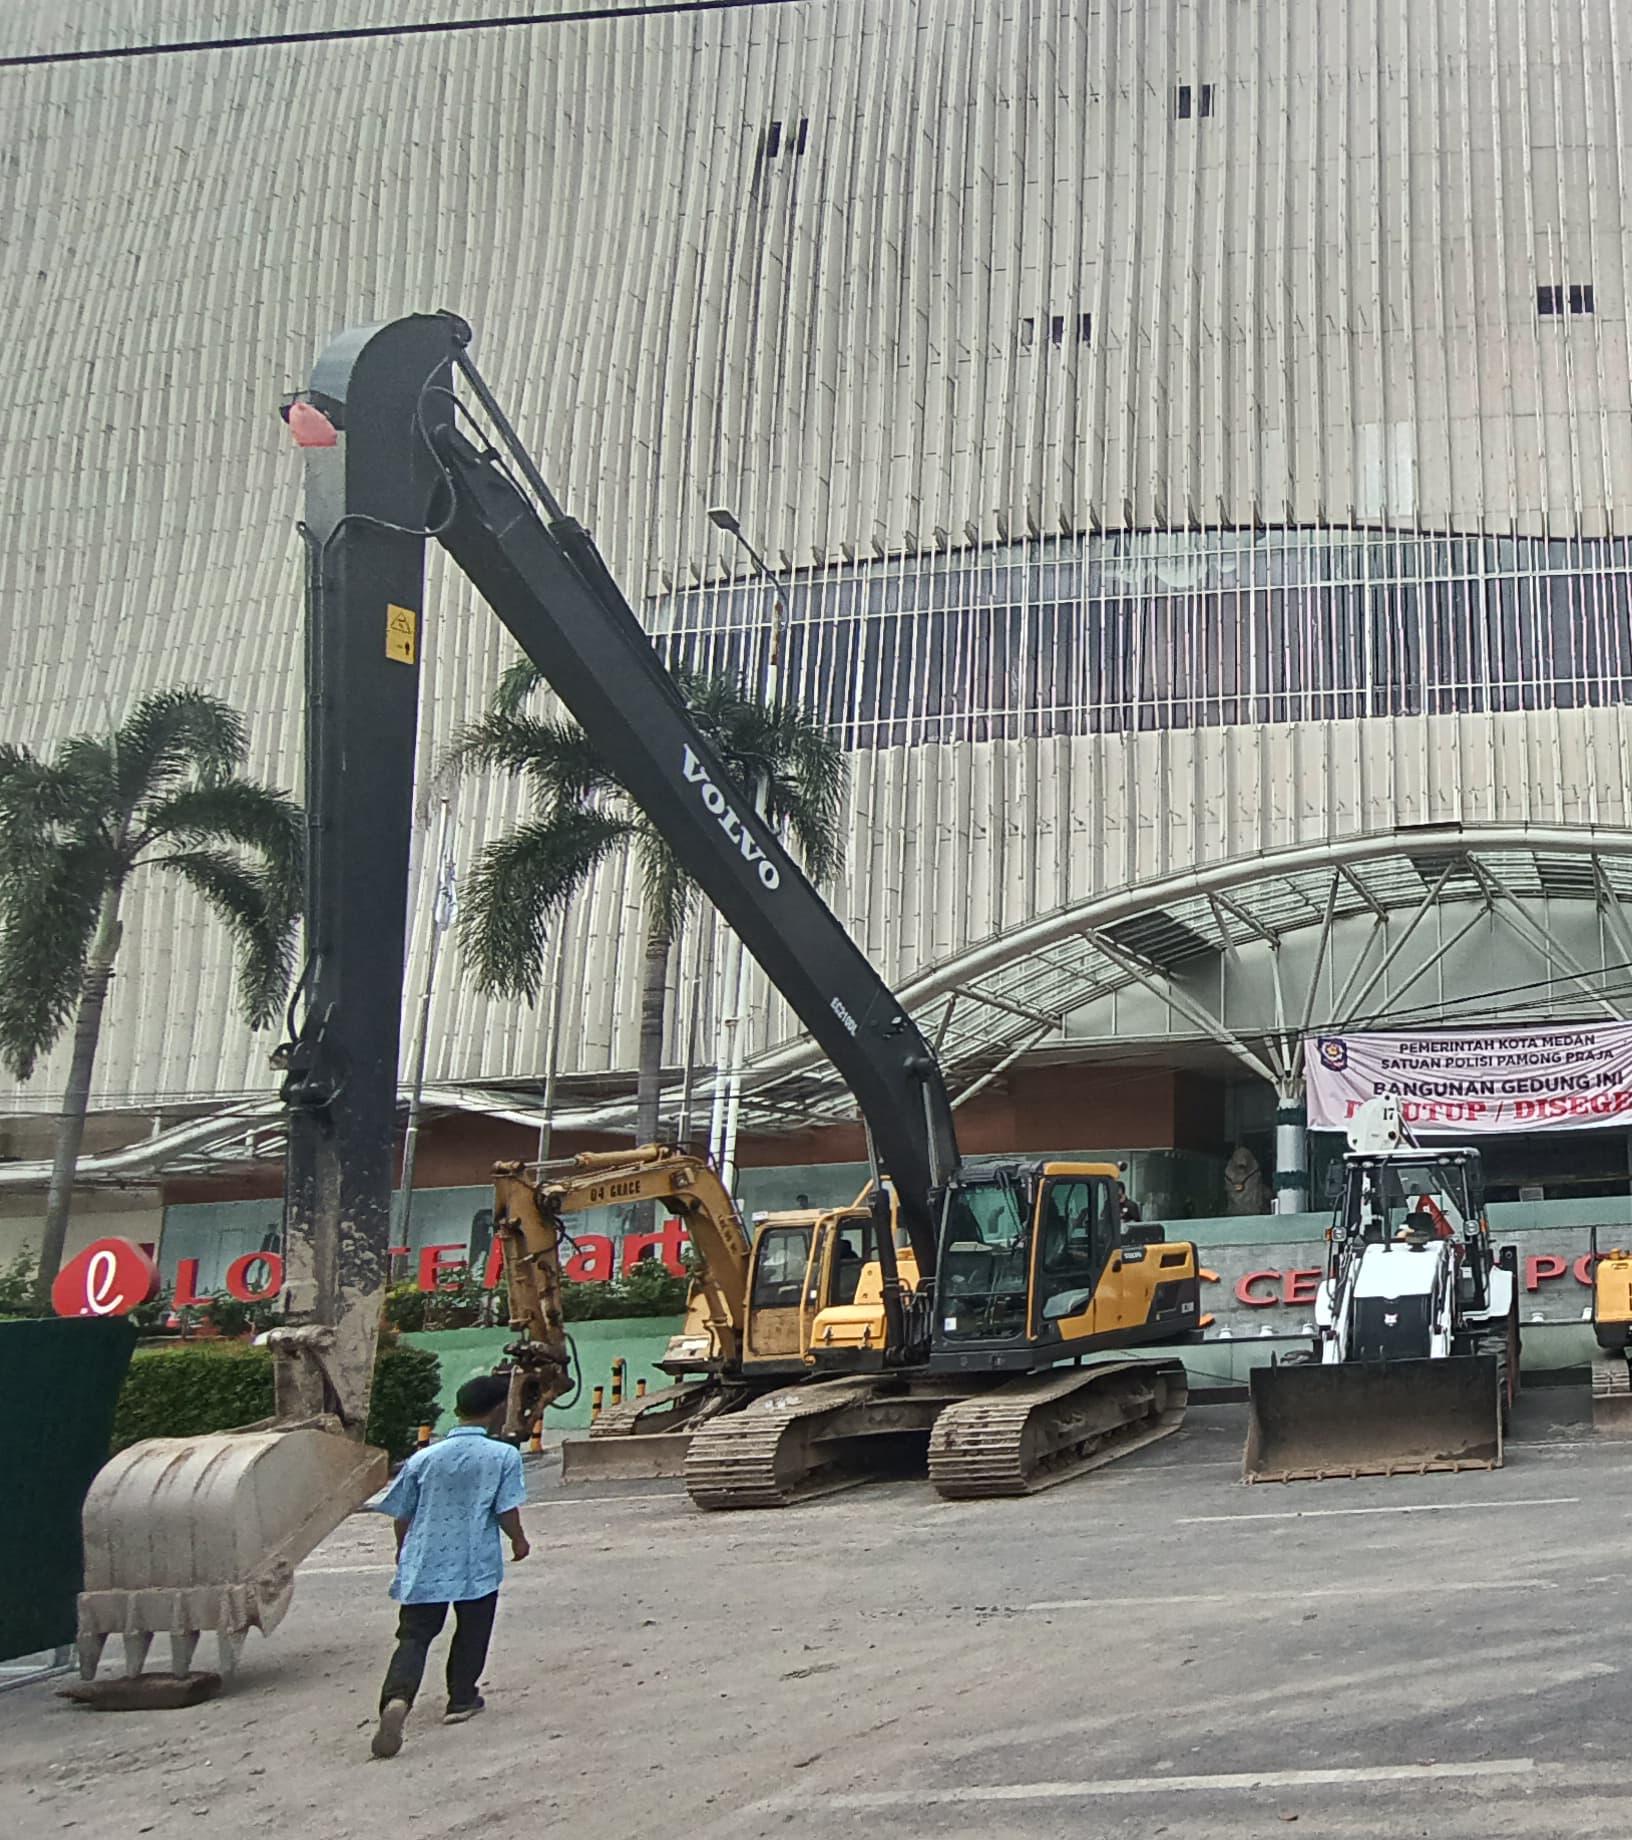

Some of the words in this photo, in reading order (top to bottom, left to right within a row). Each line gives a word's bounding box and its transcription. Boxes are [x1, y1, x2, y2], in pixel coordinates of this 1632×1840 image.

[681, 742, 780, 891] VOLVO
[1399, 1040, 1494, 1054] PEMERINTAH
[1499, 1037, 1538, 1050] KOTA
[1542, 1034, 1595, 1047] MEDAN
[1381, 1057, 1441, 1070] SATUAN
[1445, 1055, 1492, 1068] POLISI
[1497, 1050, 1561, 1066] PAMONG
[1565, 1049, 1614, 1064] PRAJA
[1373, 1081, 1495, 1096] BANGUNAN
[1501, 1073, 1590, 1093] GEDUNG
[1596, 1069, 1623, 1088] INI
[1494, 1101, 1504, 1122] /
